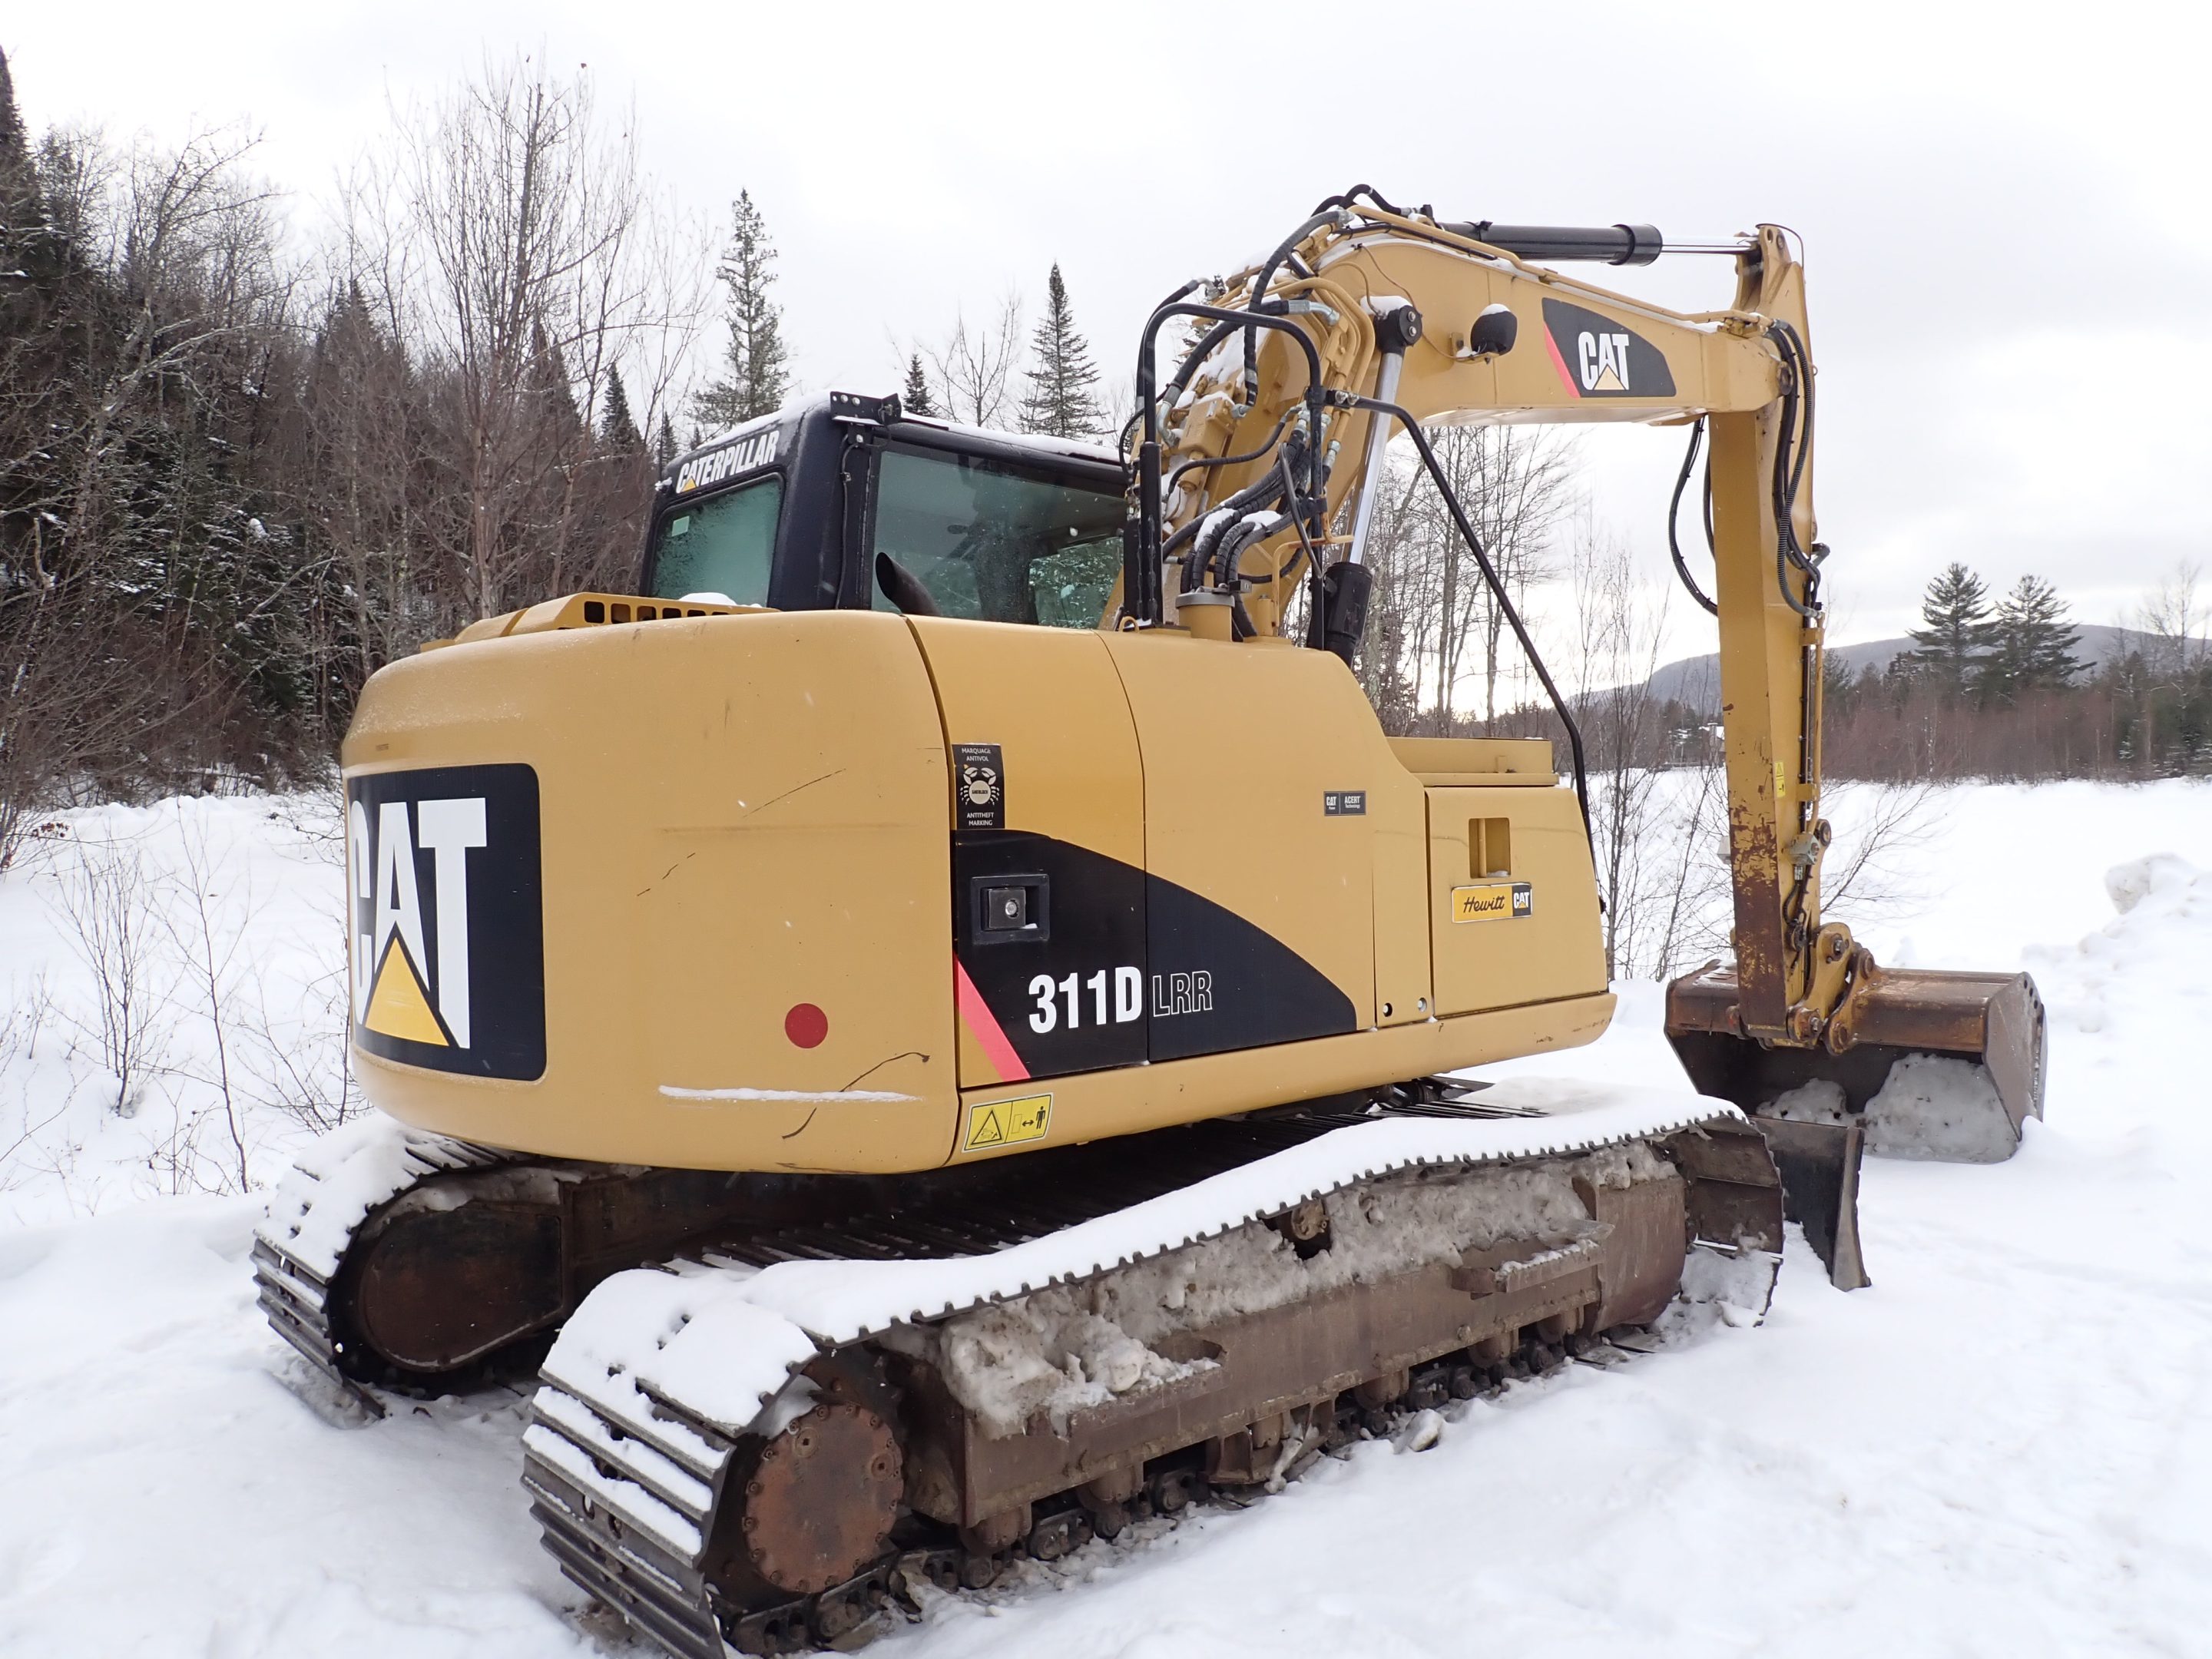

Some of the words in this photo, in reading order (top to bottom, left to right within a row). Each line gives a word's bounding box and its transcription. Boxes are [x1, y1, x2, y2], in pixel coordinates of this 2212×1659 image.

[1578, 332, 1629, 390] CAT
[676, 430, 780, 492] CATERPILLAR
[1326, 796, 1336, 806] CAT
[349, 797, 487, 1049] CAT
[1463, 896, 1505, 913] Hewitt
[1513, 892, 1530, 909] CAT
[1028, 966, 1142, 1034] 311D
[1152, 970, 1213, 1018] LRR
